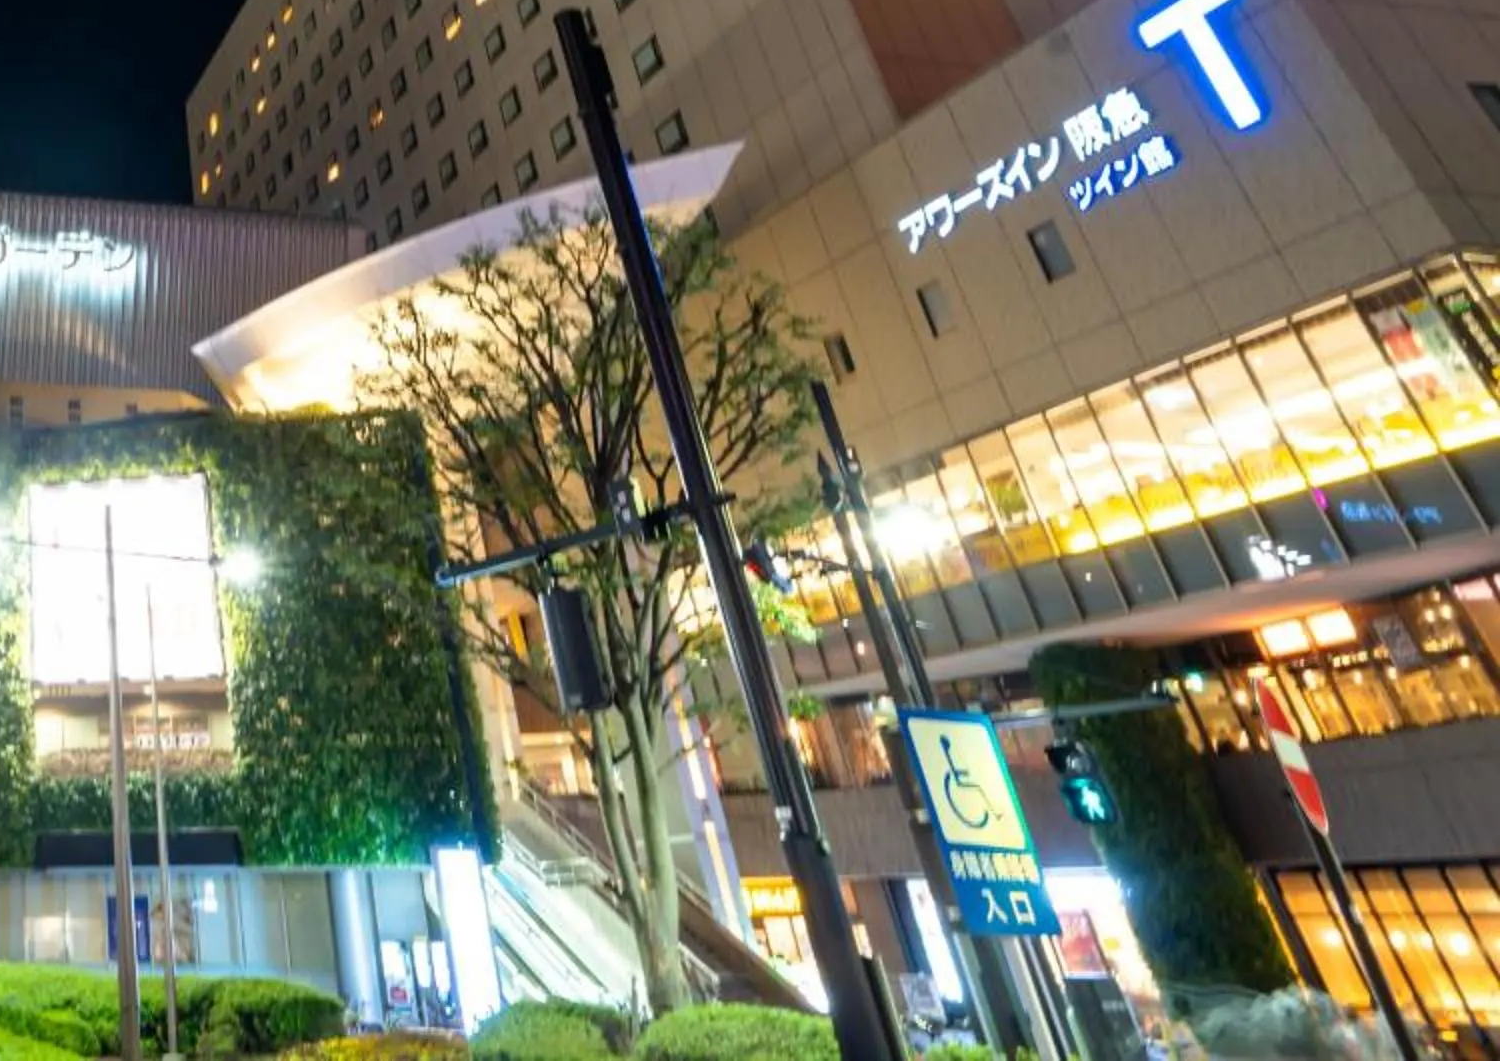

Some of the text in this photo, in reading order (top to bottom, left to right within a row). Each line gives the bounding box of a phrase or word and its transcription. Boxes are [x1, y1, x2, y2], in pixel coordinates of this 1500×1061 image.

[898, 86, 1151, 254] アワーズイン 阪急
[981, 887, 1036, 927] 入口
